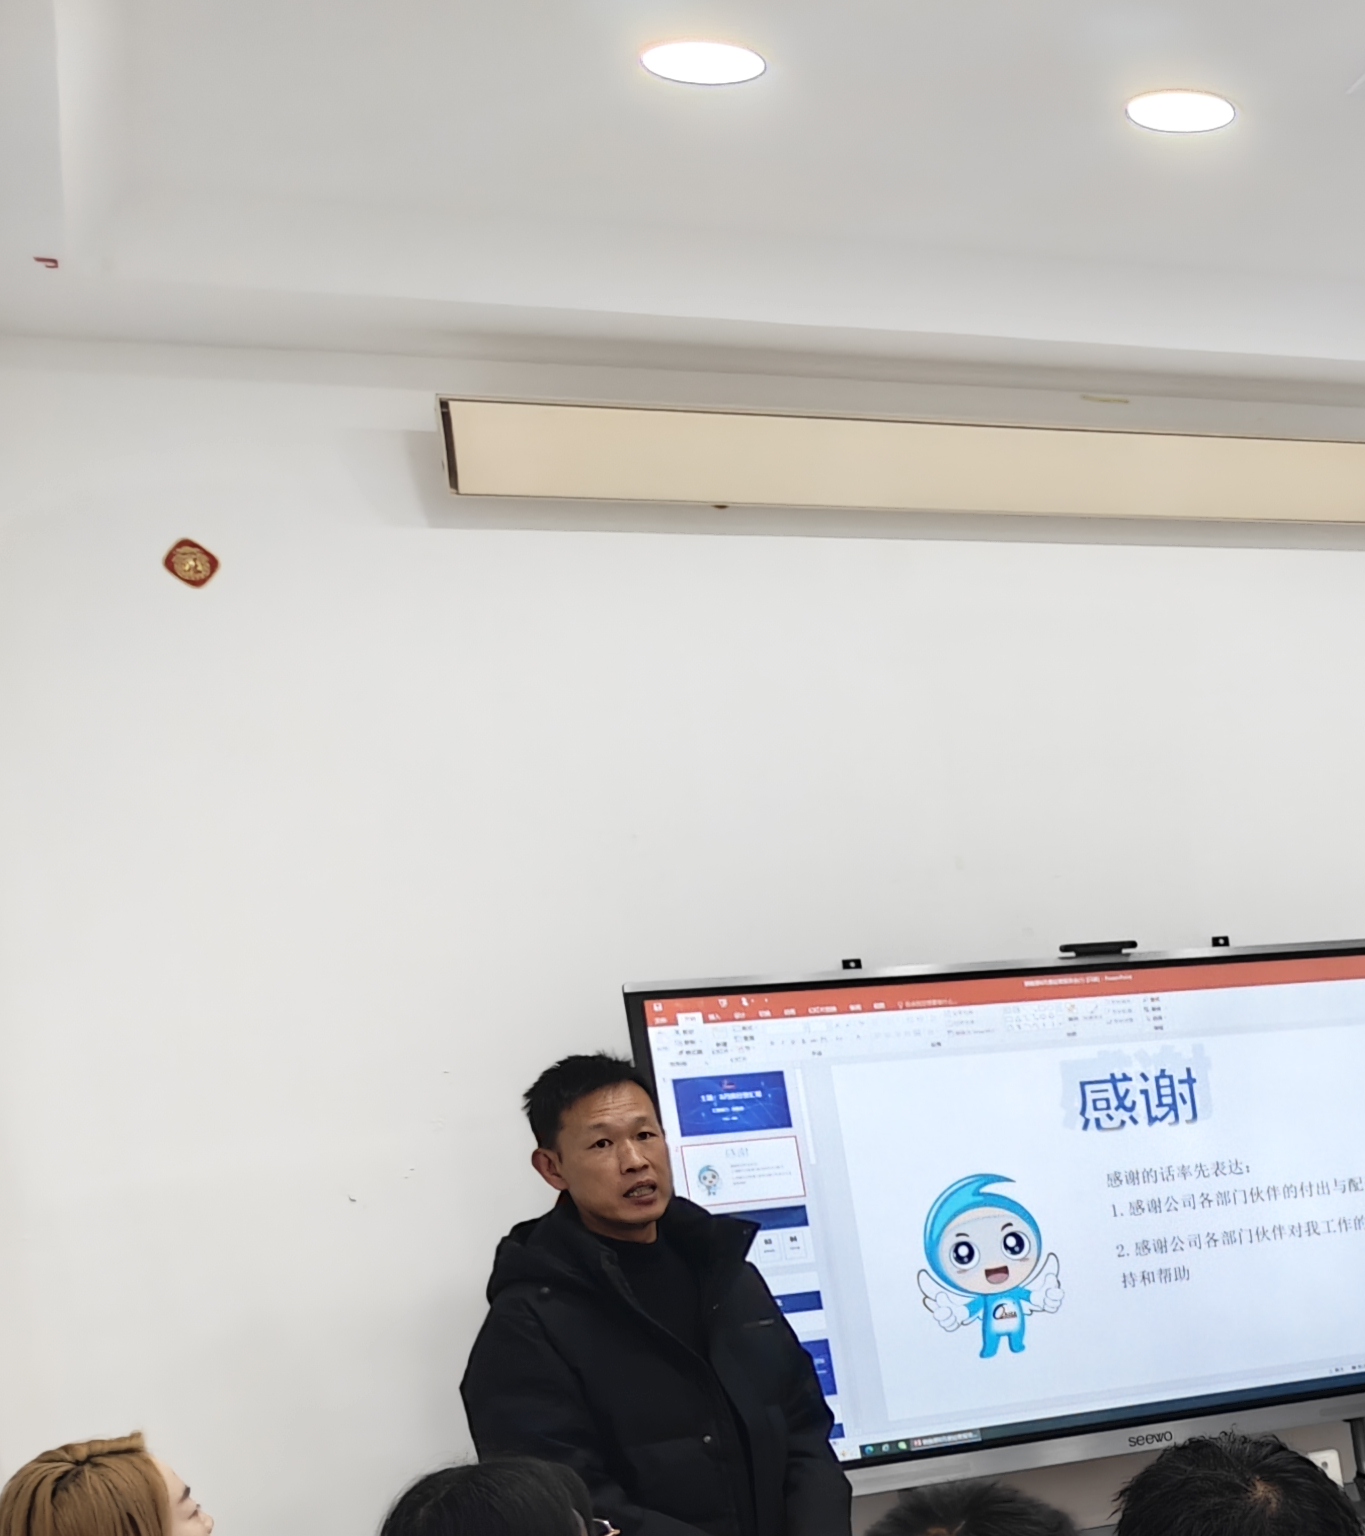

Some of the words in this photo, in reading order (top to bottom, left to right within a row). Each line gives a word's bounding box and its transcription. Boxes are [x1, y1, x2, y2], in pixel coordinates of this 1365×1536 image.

[1079, 1067, 1198, 1132] 感谢
[1121, 1265, 1191, 1289] 持和帮助
[1128, 1431, 1173, 1448] seewo
